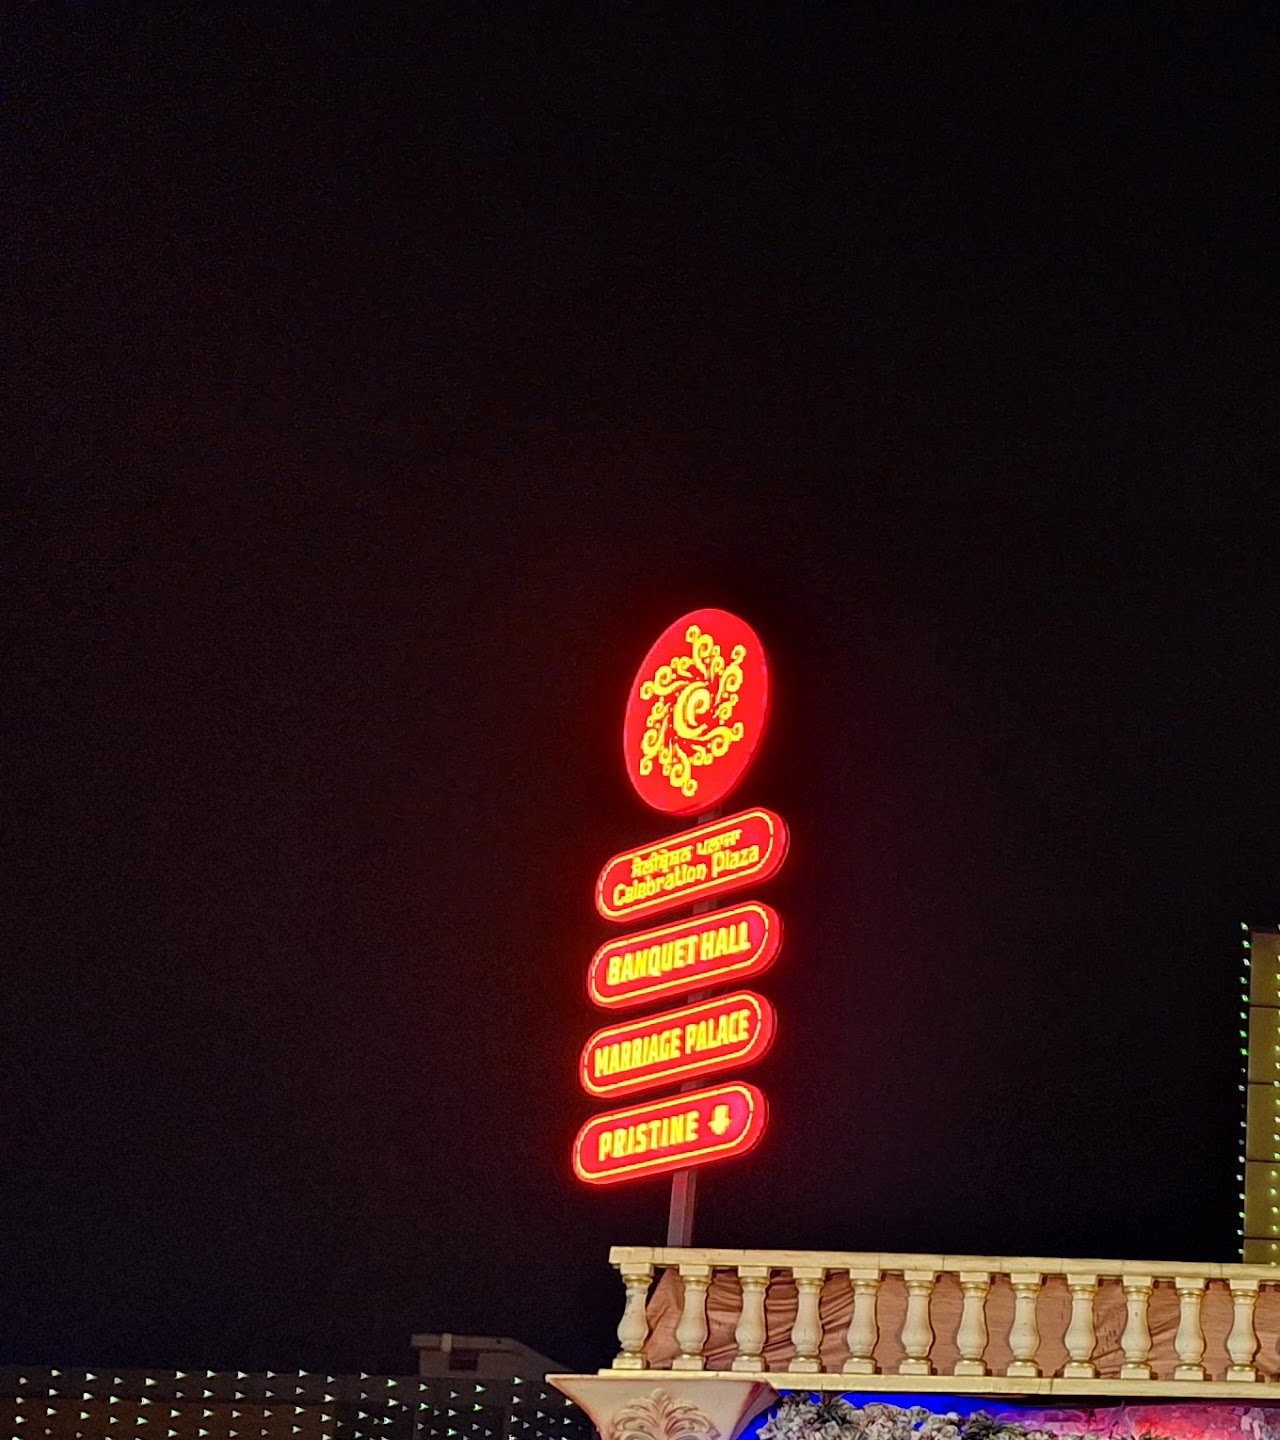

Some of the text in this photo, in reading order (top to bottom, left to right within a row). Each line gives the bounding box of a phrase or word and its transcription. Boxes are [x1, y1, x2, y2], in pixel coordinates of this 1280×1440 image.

[711, 845, 760, 878] Plaza
[606, 921, 751, 986] BANQUET HALL
[594, 1008, 751, 1078] MARRIAGE PALACE
[598, 1110, 699, 1162] PRISTINE
